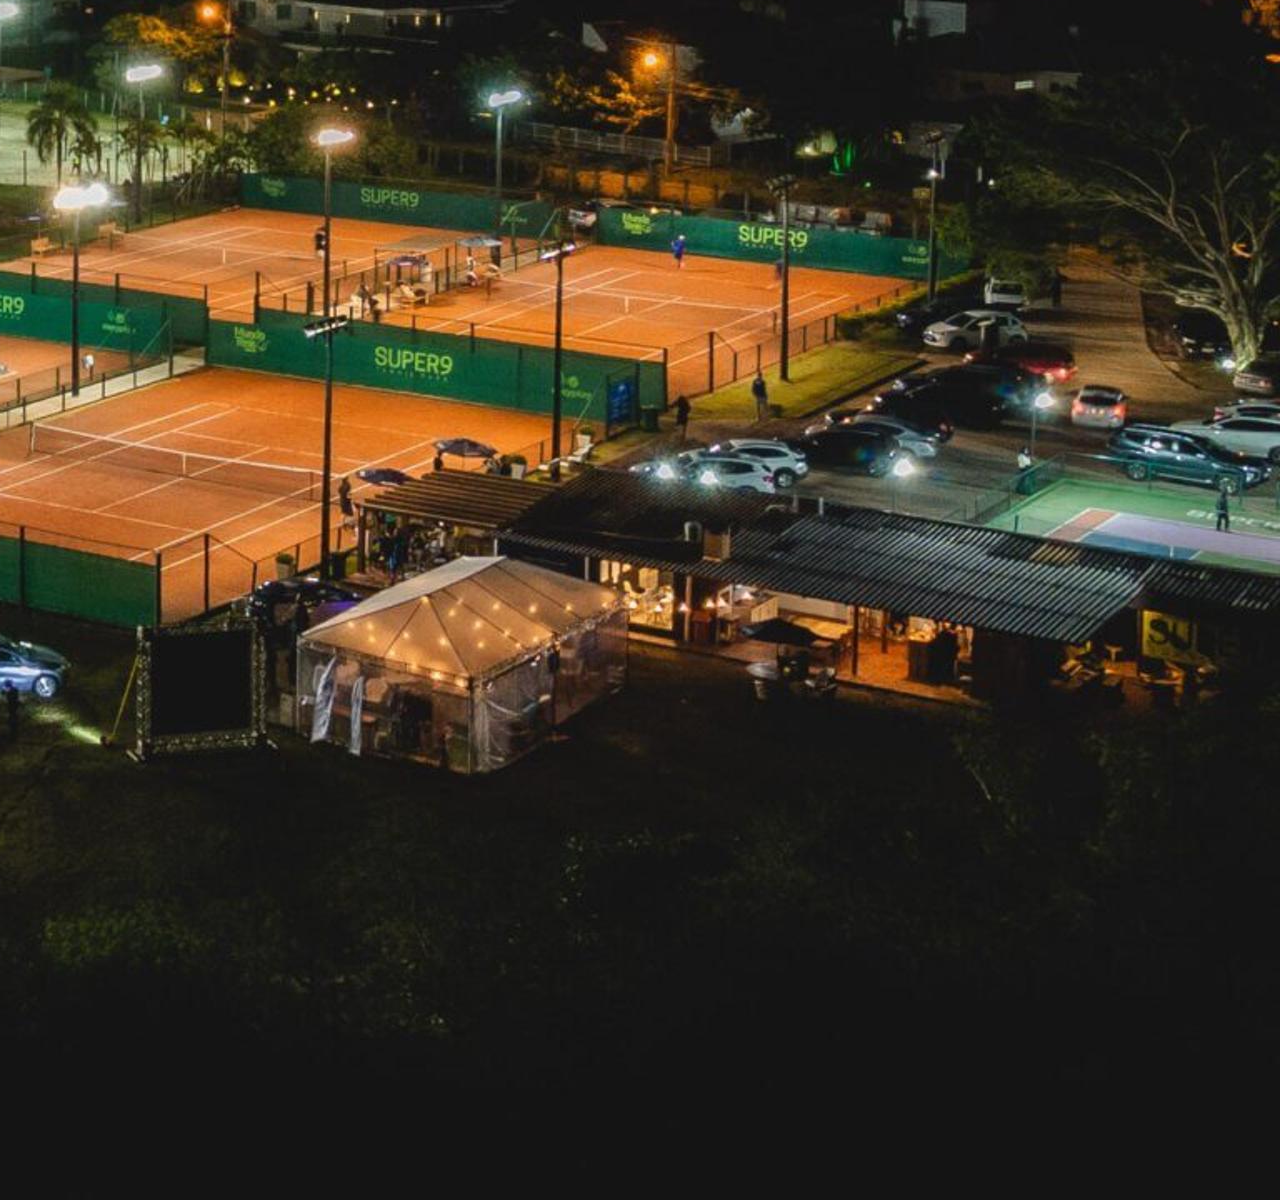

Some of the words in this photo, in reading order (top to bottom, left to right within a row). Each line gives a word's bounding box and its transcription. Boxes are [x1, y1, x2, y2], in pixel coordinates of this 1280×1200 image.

[360, 187, 420, 208] SUPER9
[739, 224, 808, 248] SUPER9
[374, 345, 454, 376] SUPER9
